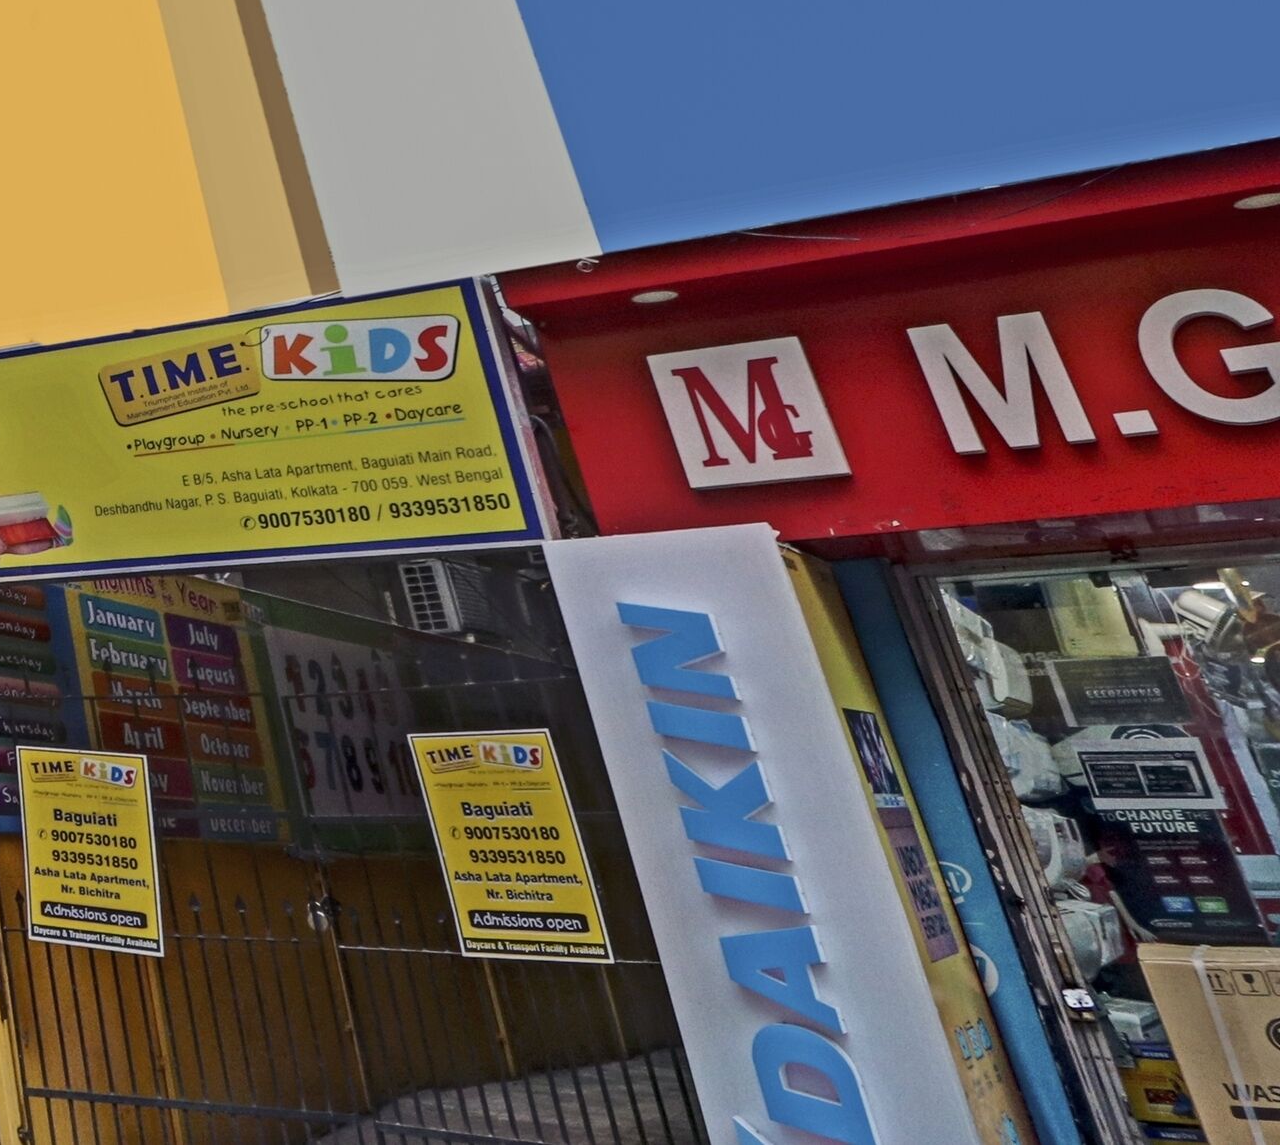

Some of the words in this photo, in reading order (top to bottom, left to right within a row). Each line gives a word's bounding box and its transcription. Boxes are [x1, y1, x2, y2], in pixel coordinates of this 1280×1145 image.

[126, 404, 176, 420] Management
[177, 393, 216, 408] Education
[143, 391, 186, 408] Triumphant
[187, 384, 219, 396] Institute
[221, 406, 246, 417] the
[249, 394, 335, 417] pre-school
[337, 390, 370, 404] that
[374, 385, 423, 400] cares
[133, 432, 206, 452] Playgroup
[220, 424, 279, 442] Nursery
[295, 417, 329, 432] PP-1
[343, 410, 378, 426] PP-2
[394, 403, 463, 423] Daycare
[181, 474, 190, 486] E
[221, 467, 252, 482] Asha
[255, 465, 282, 480] Lata
[362, 454, 415, 471] Baguiati
[418, 449, 452, 464] Main
[94, 498, 163, 517] Deshbandhu
[165, 495, 202, 511] Nagar,
[291, 484, 338, 499] Kolkata
[352, 480, 378, 493] 700
[416, 472, 451, 487] West
[456, 466, 503, 484] Bengal
[258, 504, 371, 530] 9007530180
[389, 491, 511, 519] 9339531850
[175, 579, 218, 615] Year
[87, 600, 156, 638] January
[188, 623, 219, 651] July
[426, 744, 474, 765] TIME
[30, 760, 74, 775] TIME
[52, 807, 118, 827] Baguiati
[460, 801, 534, 821] Baguiati
[1115, 809, 1186, 821] CHANGE
[1187, 811, 1213, 821] THE
[464, 825, 560, 841] 9007530180
[1130, 821, 1200, 834] FUTURE
[51, 829, 137, 850] 9007530180
[52, 849, 138, 870] 9339531850
[469, 849, 566, 865] 9339531850
[34, 866, 60, 878] Asha
[63, 869, 87, 881] Lata
[90, 873, 150, 890] Apartment,
[454, 871, 483, 882] Asha
[486, 871, 513, 883] Lata
[515, 872, 583, 887] Apartment,
[616, 601, 880, 1145] DAIKIN
[60, 884, 76, 894] Nr.
[78, 886, 121, 900] Bichitra
[486, 888, 503, 899] Nr.
[506, 889, 554, 902] Bichitra
[43, 903, 108, 923] Admissions
[110, 913, 142, 927] open
[473, 912, 544, 929] Admissions
[547, 918, 583, 932] open
[33, 925, 60, 937] Daycare
[69, 929, 101, 942] Transport
[101, 934, 125, 946] Facility
[126, 938, 158, 950] Available
[466, 940, 496, 951] Daycare
[505, 941, 540, 952] Transport
[541, 944, 568, 955] Facility
[569, 945, 605, 956] Available
